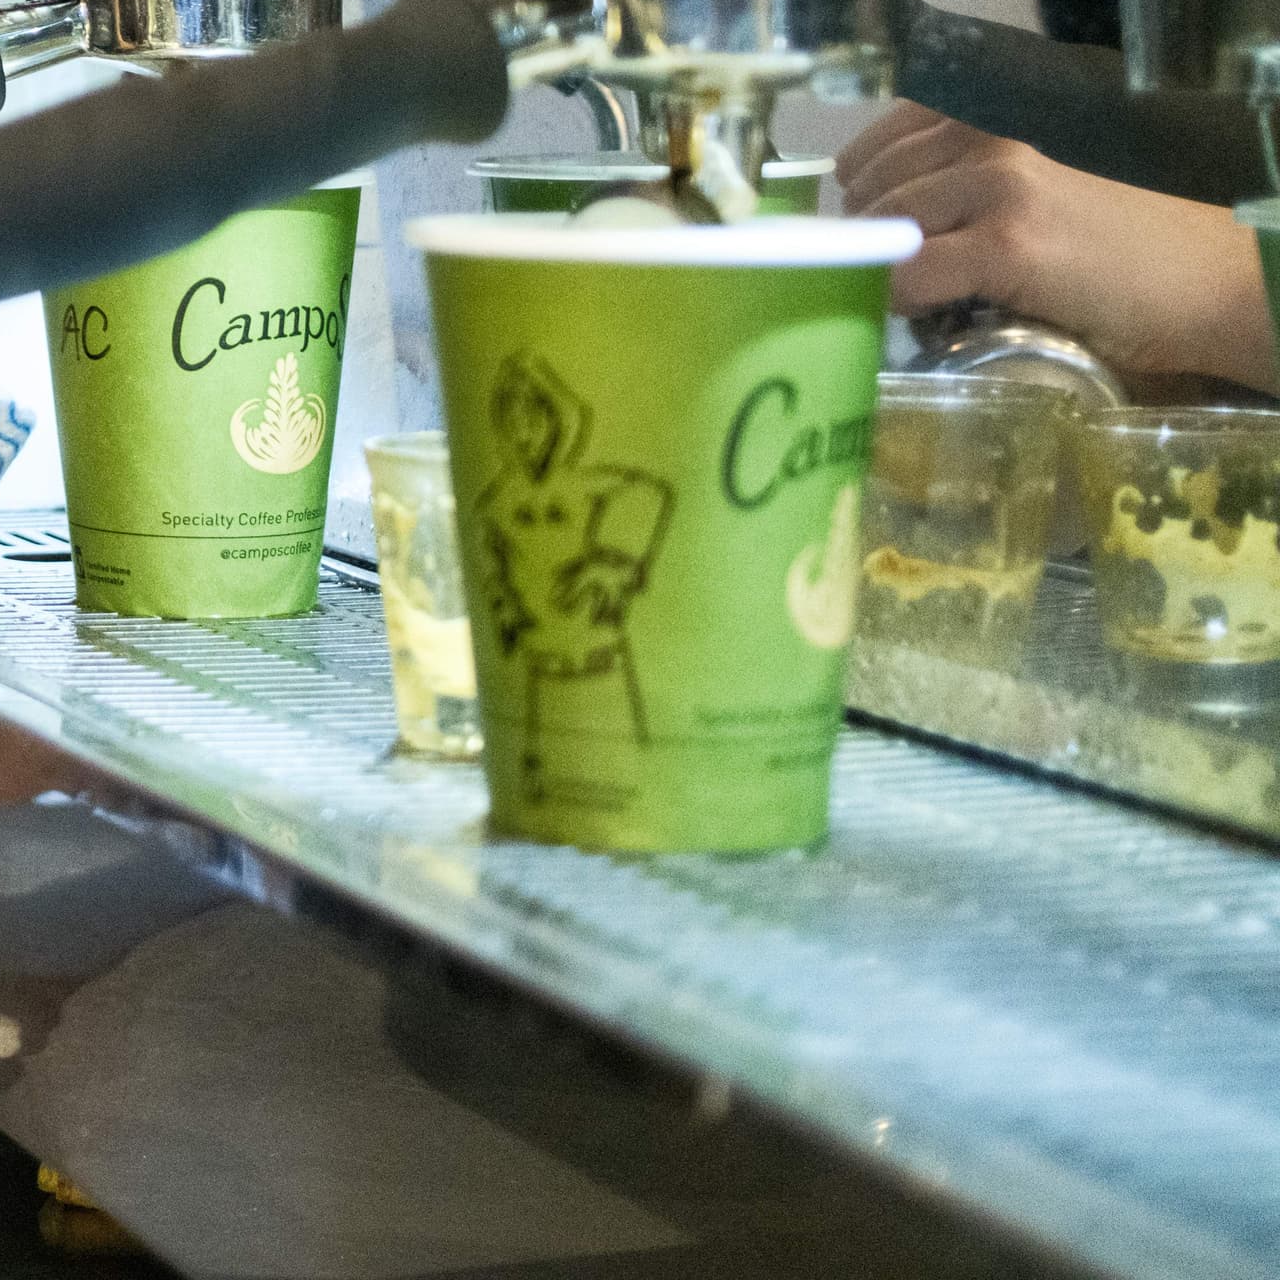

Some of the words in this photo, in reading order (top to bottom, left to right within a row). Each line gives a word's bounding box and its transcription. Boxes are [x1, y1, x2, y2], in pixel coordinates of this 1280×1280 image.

[60, 303, 111, 361] AC
[162, 511, 234, 530] Specialty
[238, 511, 283, 527] Coffee
[220, 540, 312, 561] @camposcoffee
